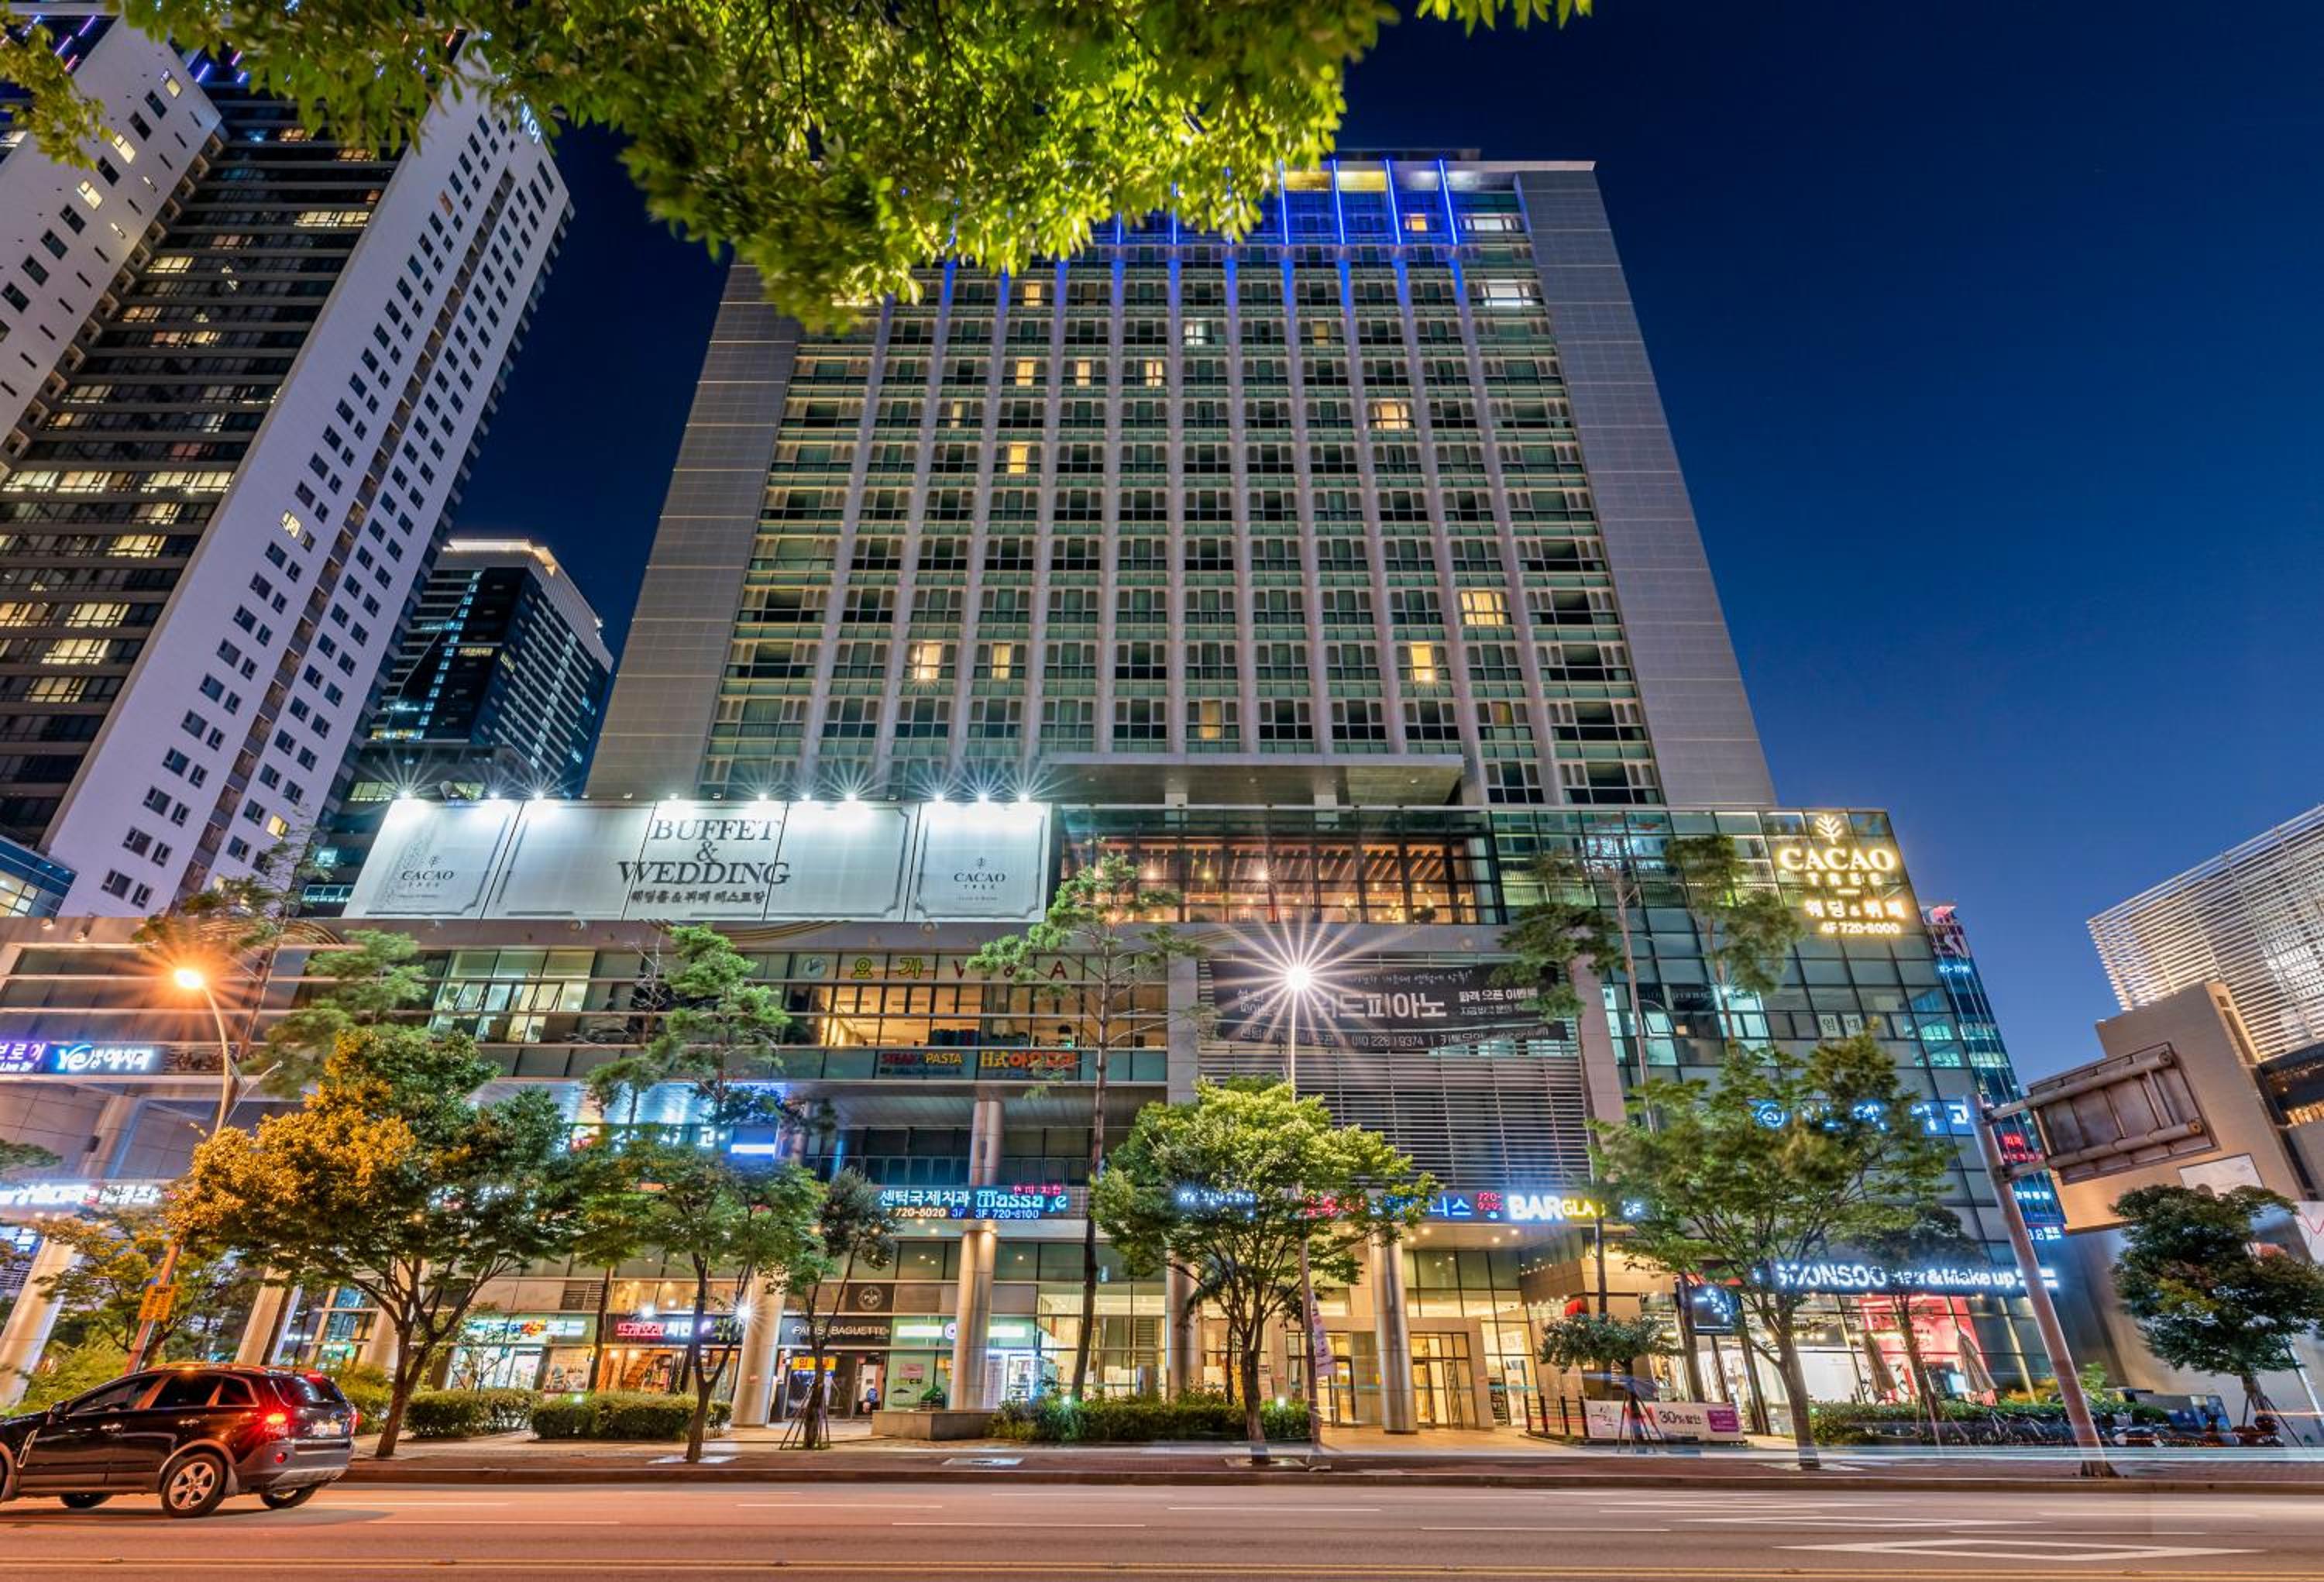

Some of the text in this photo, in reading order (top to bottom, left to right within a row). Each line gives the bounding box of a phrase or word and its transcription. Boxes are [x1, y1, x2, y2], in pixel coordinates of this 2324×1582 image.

[651, 819, 781, 840] BUFFET
[696, 841, 718, 862] &
[1779, 848, 1896, 871] CACAO
[402, 870, 454, 880] CACAO
[618, 861, 791, 884] WEDDING
[954, 872, 1006, 882] CACAO
[851, 957, 924, 979] 요가
[926, 1053, 962, 1064] PASTA
[895, 1208, 946, 1217] 720-8020
[976, 1209, 988, 1219] 3F
[1508, 1195, 1563, 1220] BAR
[1993, 1271, 2015, 1288] up
[793, 1326, 886, 1335] PAIS BAGUETTE
